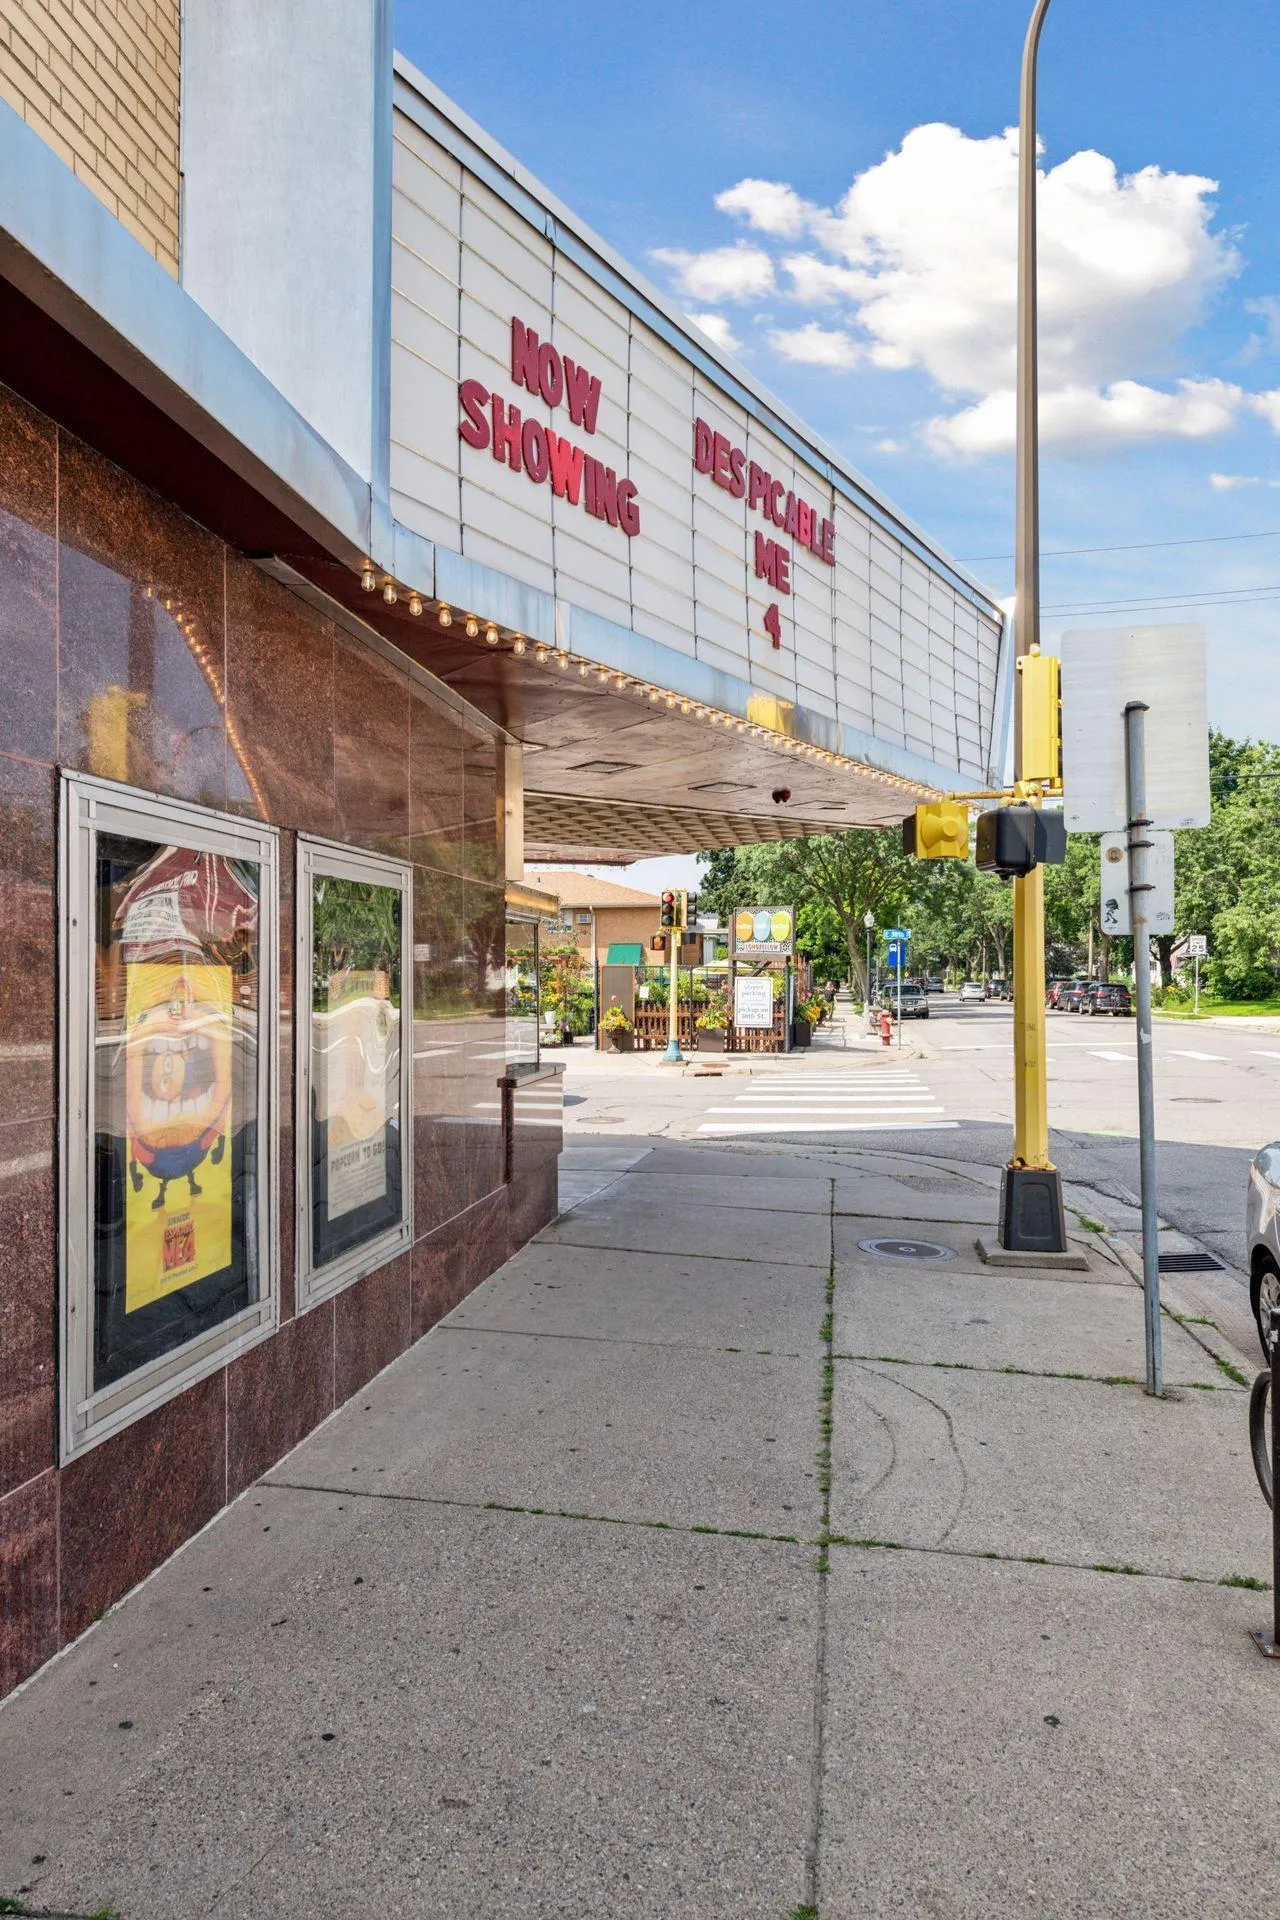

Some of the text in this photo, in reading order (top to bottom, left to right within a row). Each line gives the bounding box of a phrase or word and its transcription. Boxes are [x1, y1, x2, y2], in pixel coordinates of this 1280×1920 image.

[511, 316, 602, 434] NOW
[458, 378, 641, 537] SHOWING
[694, 416, 836, 567] DESPICABLE
[754, 530, 791, 595] ME
[763, 602, 782, 650] 4
[745, 943, 779, 951] LONGFELLOW
[1191, 944, 1205, 952] 25
[362, 1145, 371, 1161] TO
